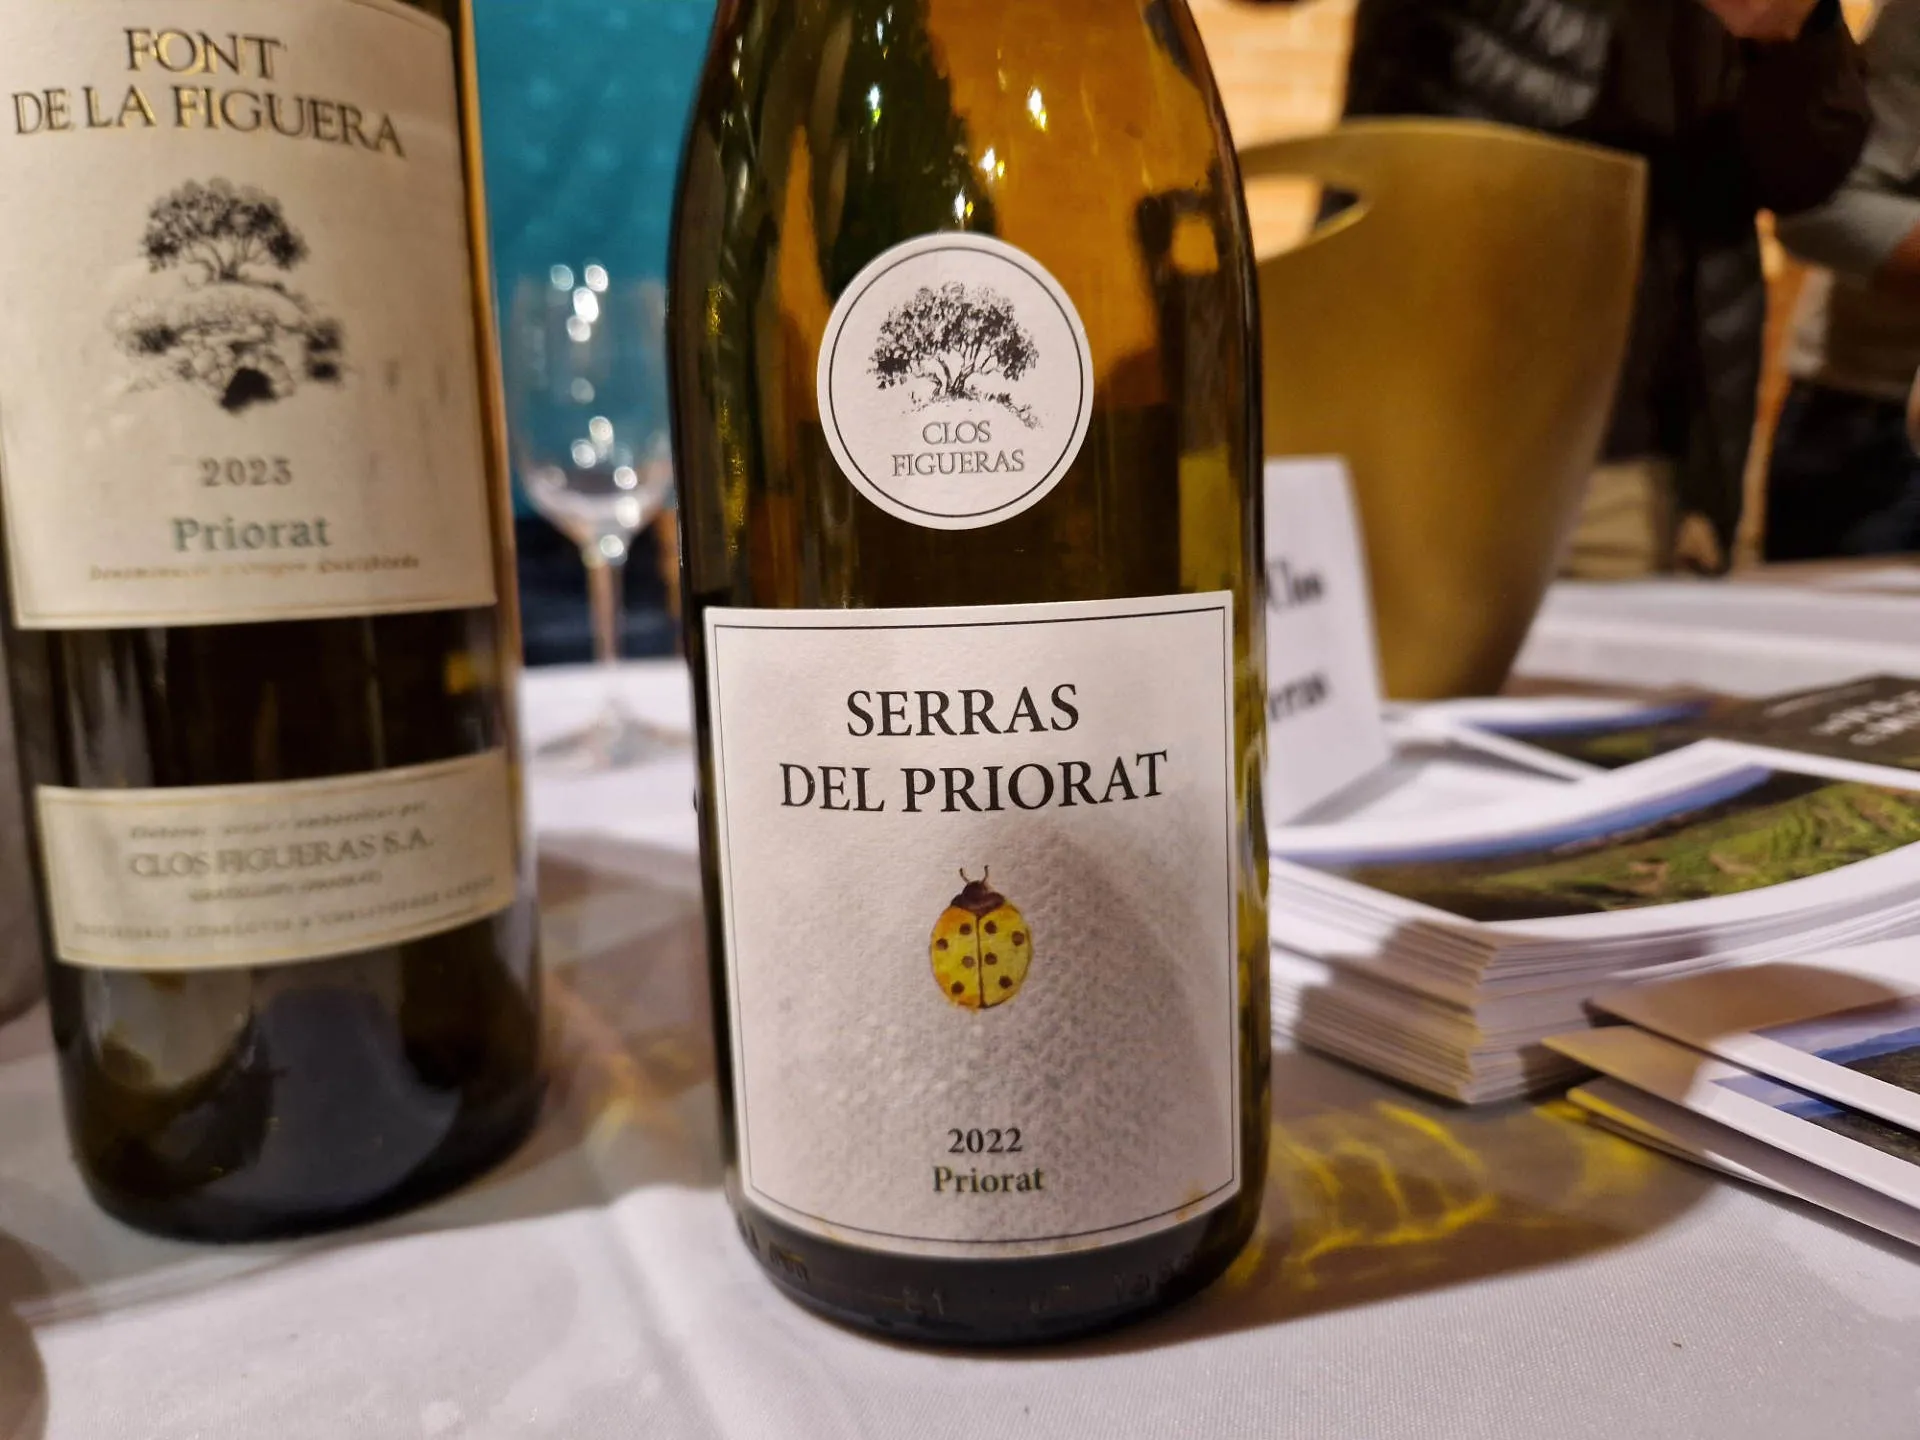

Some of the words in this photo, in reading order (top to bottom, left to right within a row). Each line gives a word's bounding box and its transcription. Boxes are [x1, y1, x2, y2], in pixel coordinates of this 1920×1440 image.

[124, 27, 283, 80] FONT
[12, 88, 71, 135] DE
[81, 84, 157, 129] LA
[170, 84, 407, 159] FIGUERA
[922, 420, 992, 446] CLOS
[199, 456, 293, 487] 2023
[891, 449, 1026, 477] FIGUERAS
[170, 514, 333, 552] Priorat
[846, 683, 1080, 737] SERRAS
[779, 762, 886, 812] DEL
[899, 749, 1168, 812] PRIORAT
[130, 848, 210, 879] CLOS
[217, 834, 376, 876] FIGUERAS
[947, 1126, 1024, 1154] 2022
[932, 1164, 1047, 1194] Priorat
